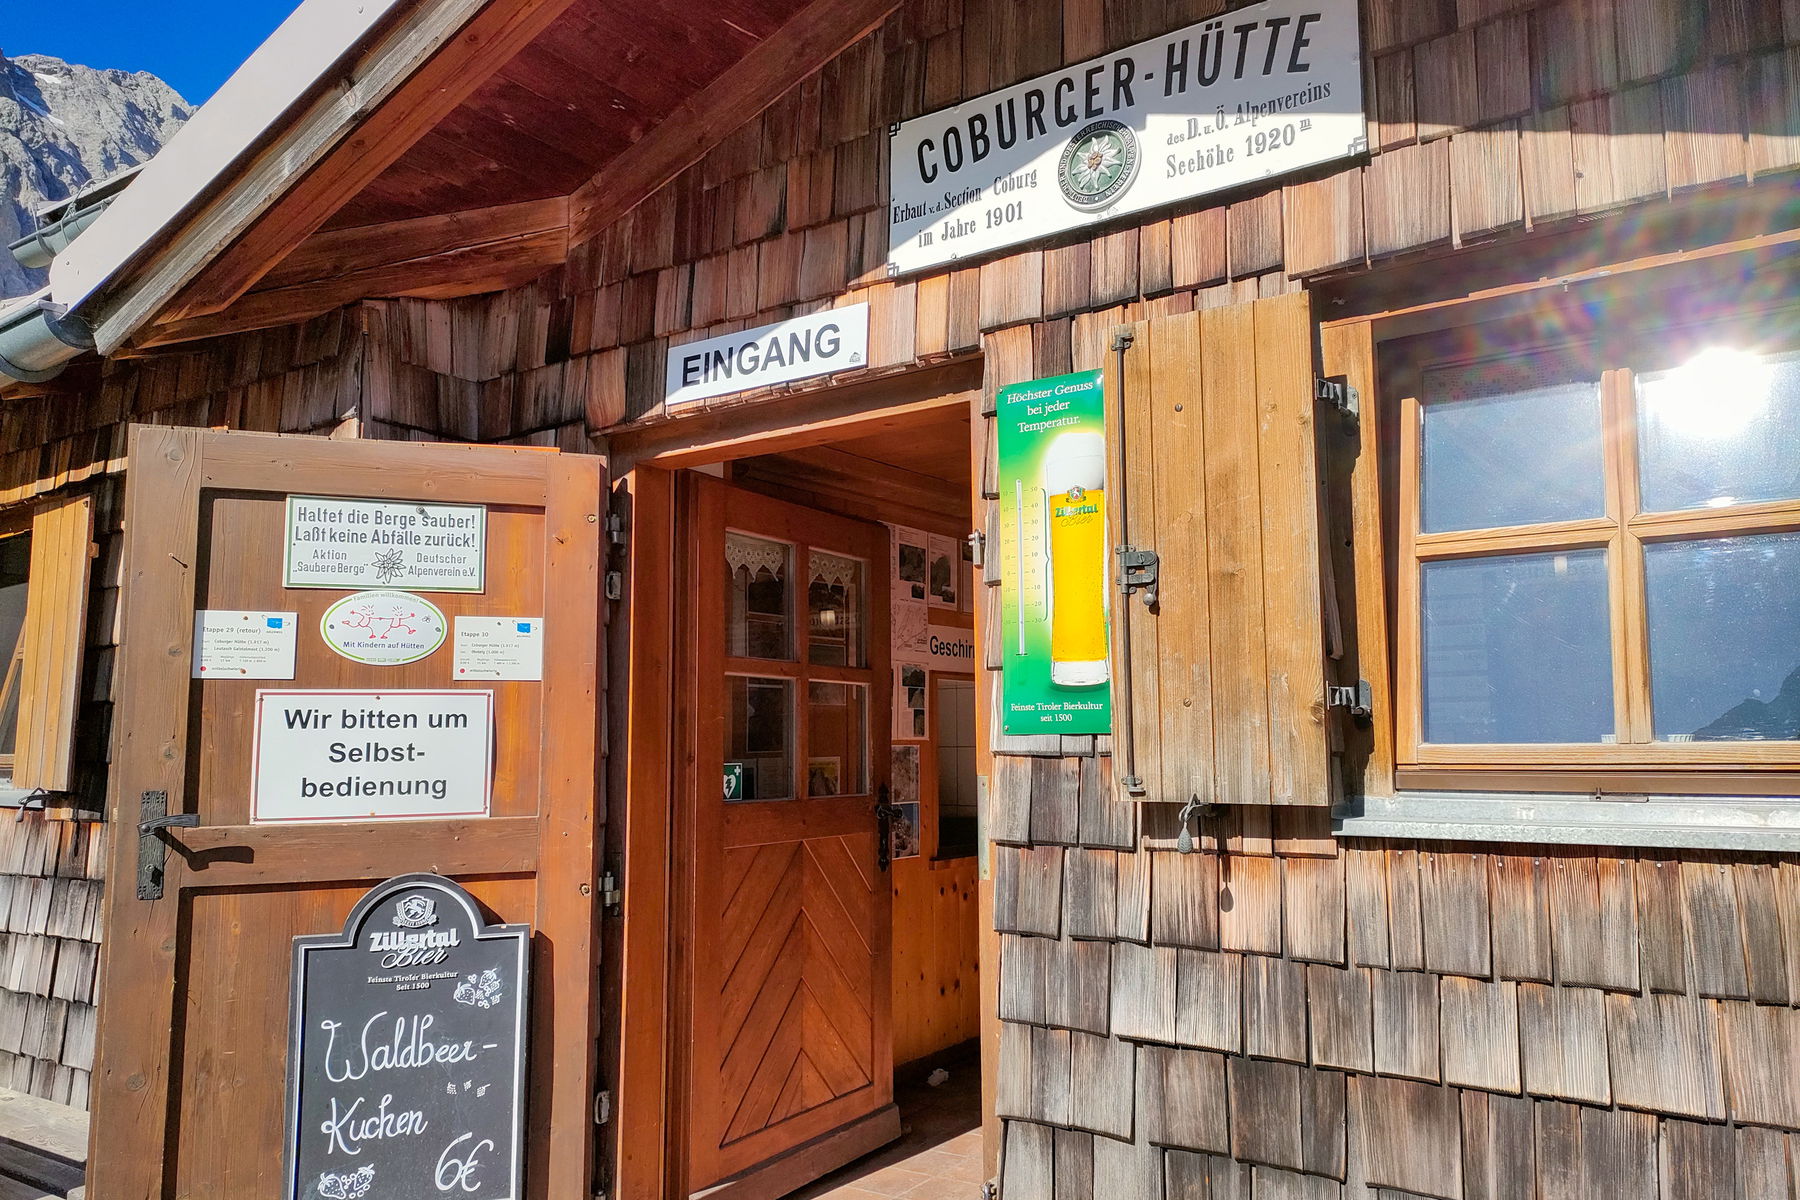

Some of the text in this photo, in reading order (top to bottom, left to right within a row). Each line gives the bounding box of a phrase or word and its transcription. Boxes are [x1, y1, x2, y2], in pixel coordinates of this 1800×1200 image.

[1167, 133, 1184, 146] des
[1234, 82, 1331, 127] Alpenvereins
[1167, 144, 1234, 179] Seehöhe
[1245, 123, 1296, 157] 1920
[893, 201, 926, 224] Erbaut
[944, 187, 982, 210] Section
[994, 169, 1037, 195] Coburg
[918, 201, 1023, 248] im Jahre 1901
[682, 324, 840, 388] EINGANG
[1006, 382, 1094, 404] Höchster Genuss
[1027, 400, 1070, 416] bei jeder
[1017, 416, 1081, 433] Temperatur.
[298, 507, 476, 529] Haltet die Berge sauber!
[295, 526, 475, 548] Laßt keine Abfälle zurück!
[312, 549, 347, 560] Aktion
[417, 553, 467, 564] Deutscher
[408, 565, 476, 577] Alpenverein e.V.
[1011, 702, 1103, 711] Feinste Tiroler Bierkultur
[284, 709, 468, 729] Wir bitten um
[1040, 714, 1072, 722] seit 1500
[328, 742, 425, 762] Selbst-
[301, 777, 447, 800] bedienung
[369, 928, 460, 952] Zillertal
[381, 945, 448, 968] Bier
[321, 1094, 428, 1156] Kuchen
[434, 1132, 494, 1192] 6€
